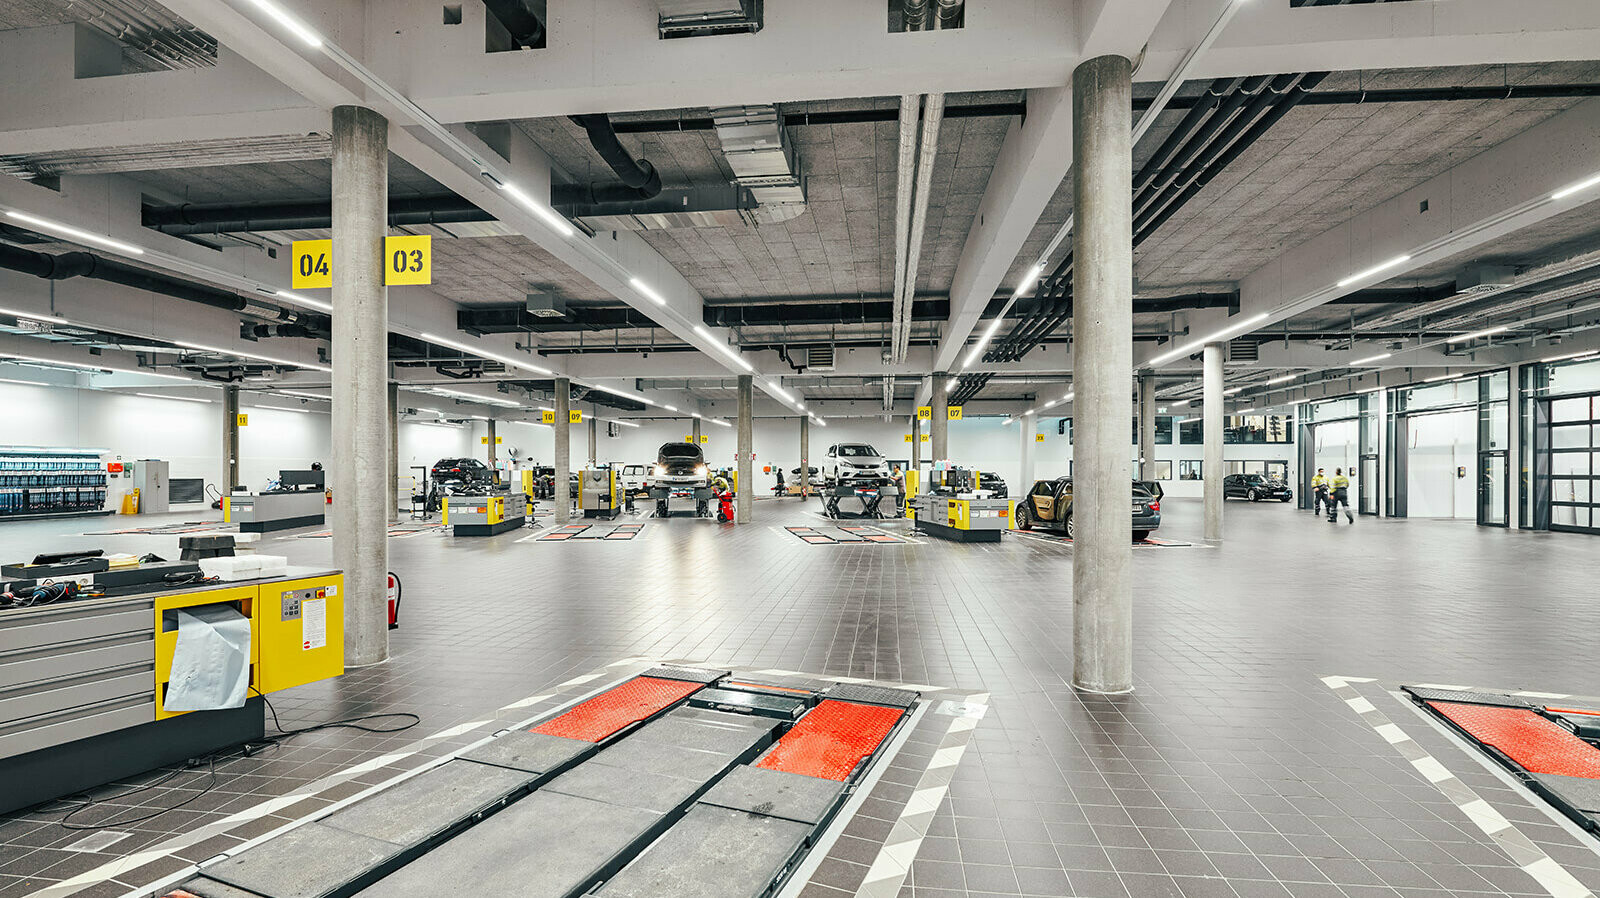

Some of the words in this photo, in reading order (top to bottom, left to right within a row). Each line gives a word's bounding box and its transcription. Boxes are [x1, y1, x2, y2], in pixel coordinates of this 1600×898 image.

[299, 253, 329, 277] 04
[394, 249, 423, 273] 03
[920, 409, 929, 417] 08
[951, 409, 960, 417] 07
